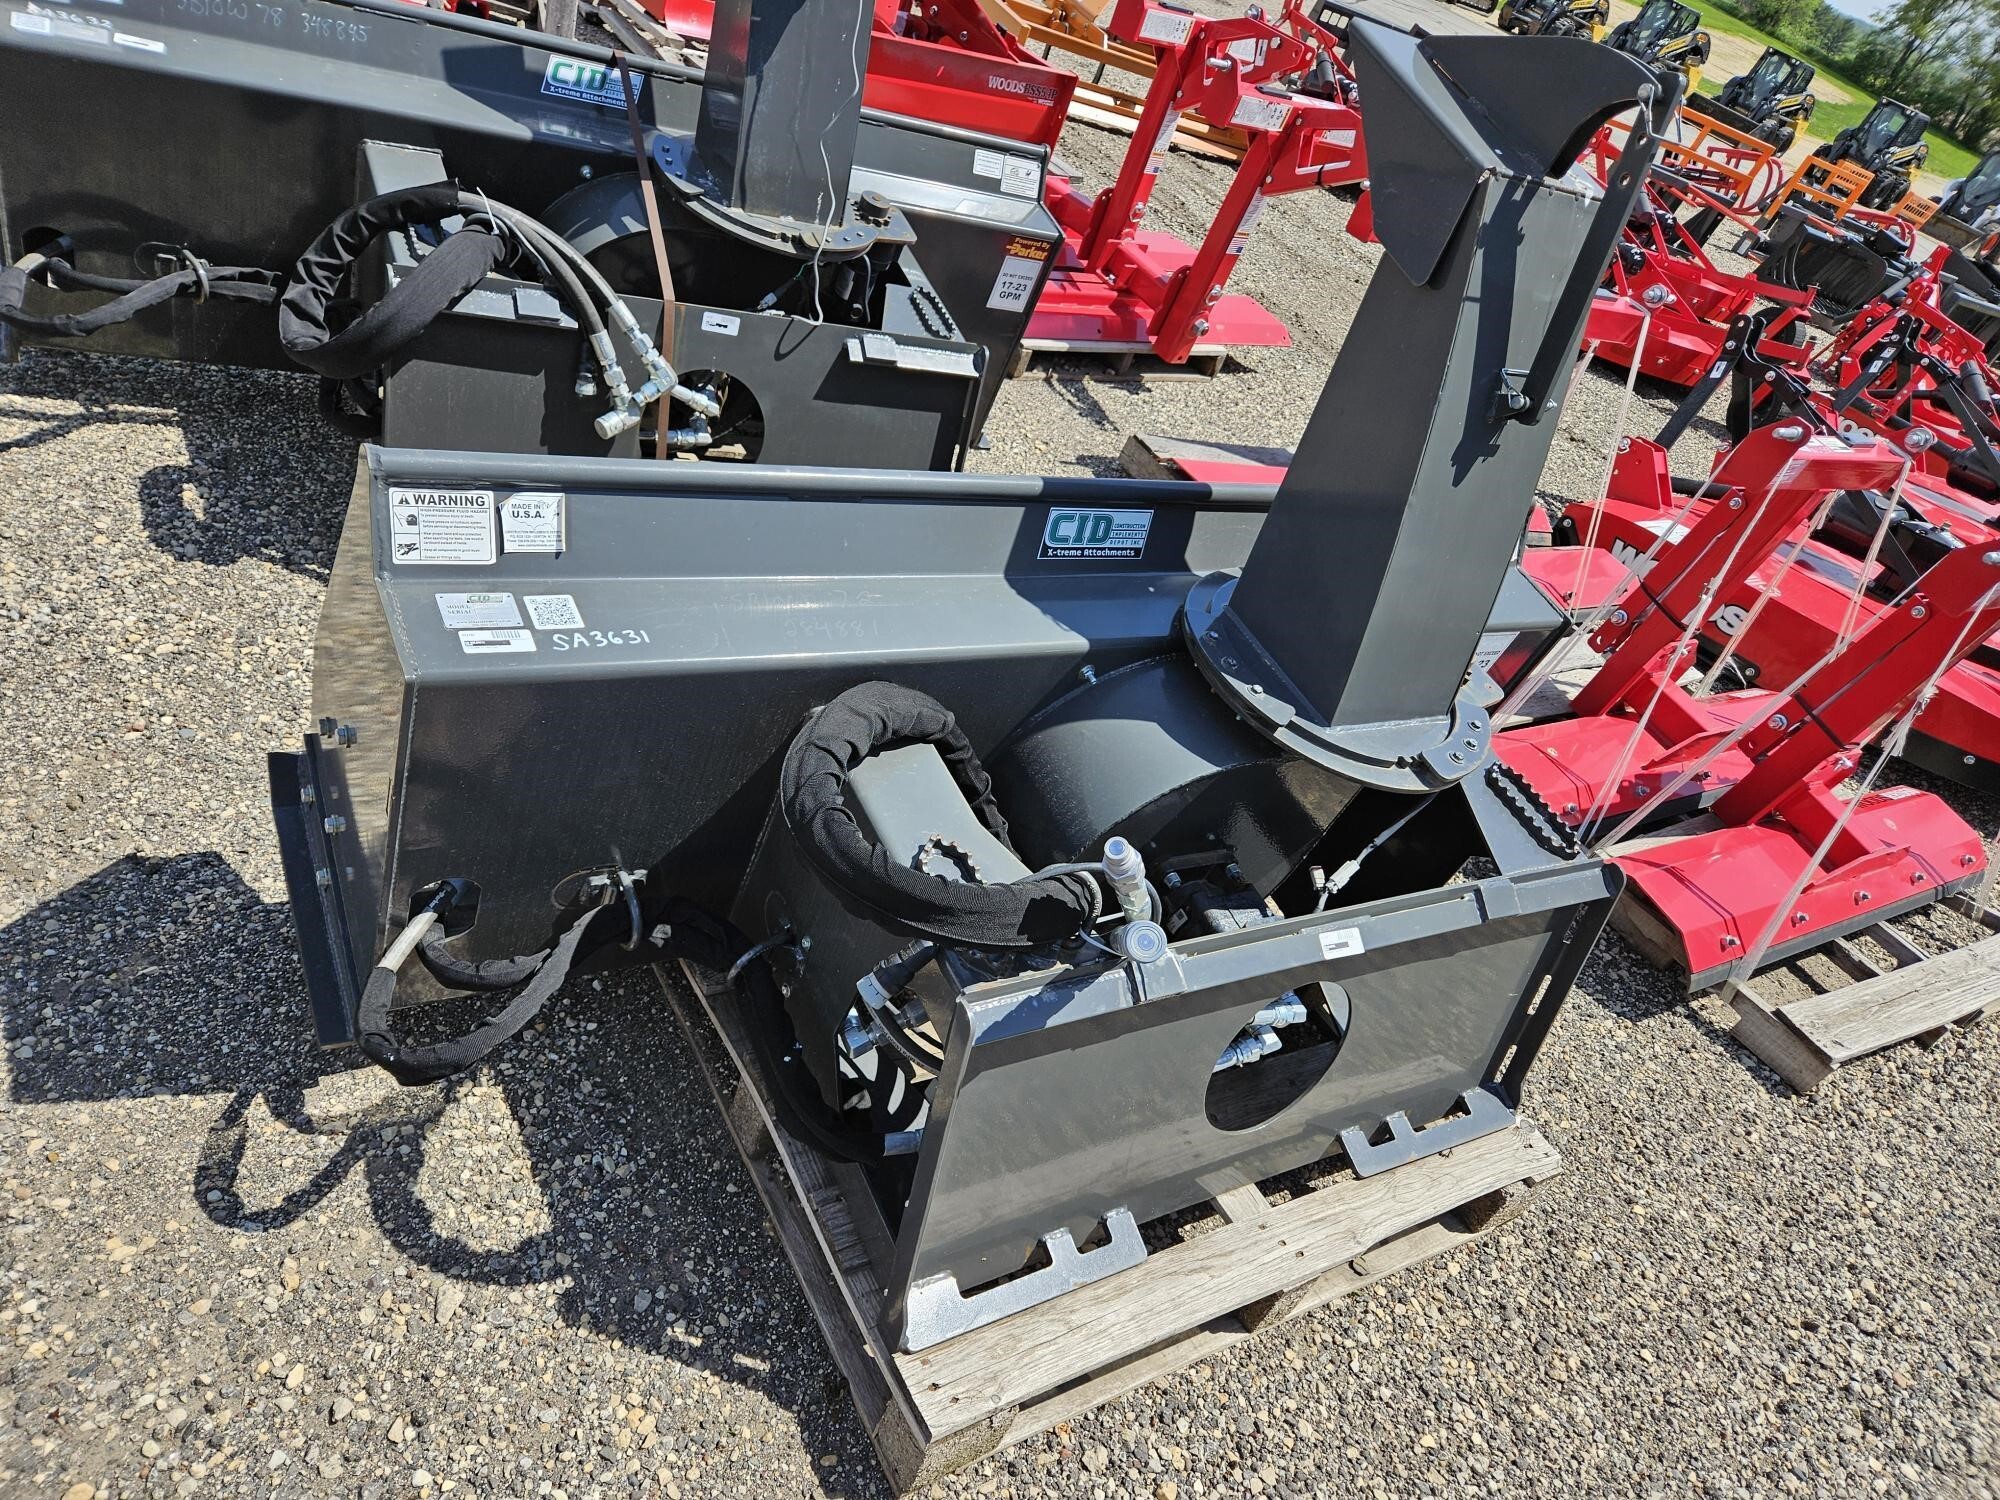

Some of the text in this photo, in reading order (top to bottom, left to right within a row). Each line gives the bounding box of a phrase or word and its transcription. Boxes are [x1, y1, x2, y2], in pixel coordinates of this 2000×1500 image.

[255, 3, 283, 26] 78
[547, 60, 608, 92] CID
[549, 85, 581, 98] X-treme
[988, 75, 1026, 94] WOODS
[1015, 237, 1041, 247] Powered
[1006, 243, 1048, 260] Parker
[1001, 281, 1028, 292] 17-23
[999, 290, 1022, 301] GPM
[413, 493, 486, 507] WARNING
[512, 510, 546, 519] U.S.A.
[1047, 512, 1114, 546] CID
[1047, 548, 1135, 557] X-treme Attachments
[552, 629, 650, 651] SA3631
